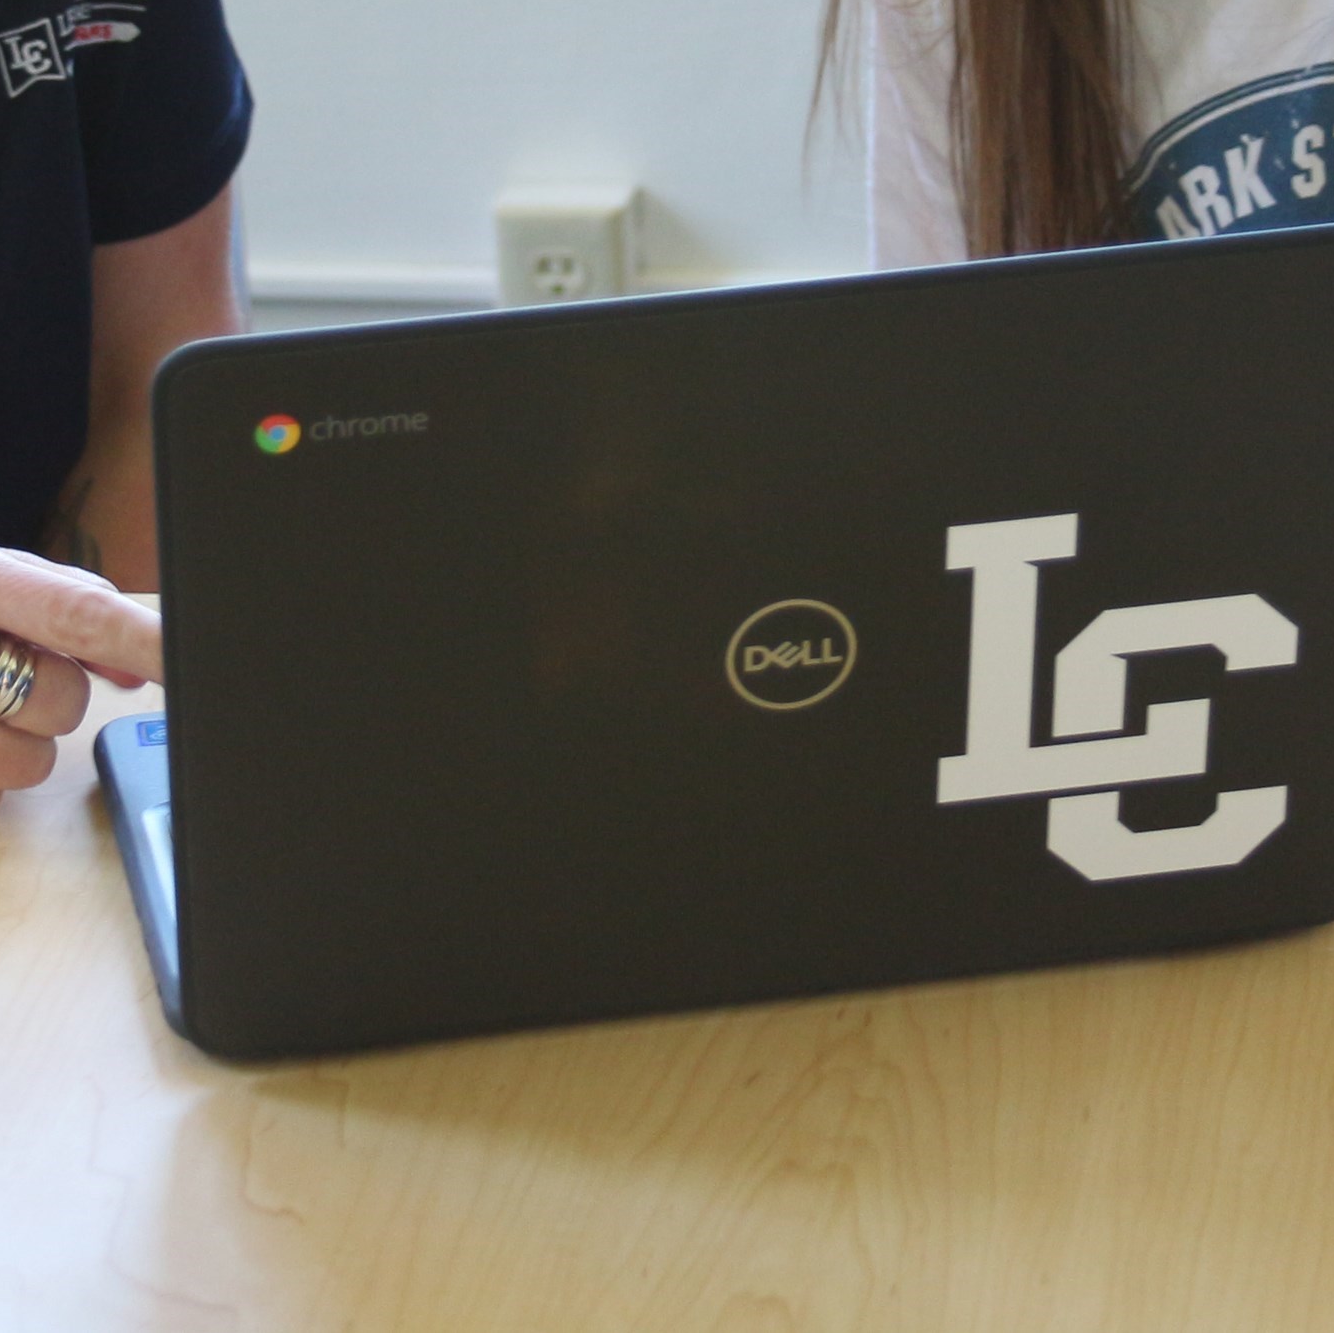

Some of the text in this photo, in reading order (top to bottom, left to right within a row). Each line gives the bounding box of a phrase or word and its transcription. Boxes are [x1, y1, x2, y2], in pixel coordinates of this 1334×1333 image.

[3, 35, 53, 75] LC
[310, 411, 429, 441] chrome
[744, 637, 844, 672] DELL
[936, 513, 1299, 882] LC
